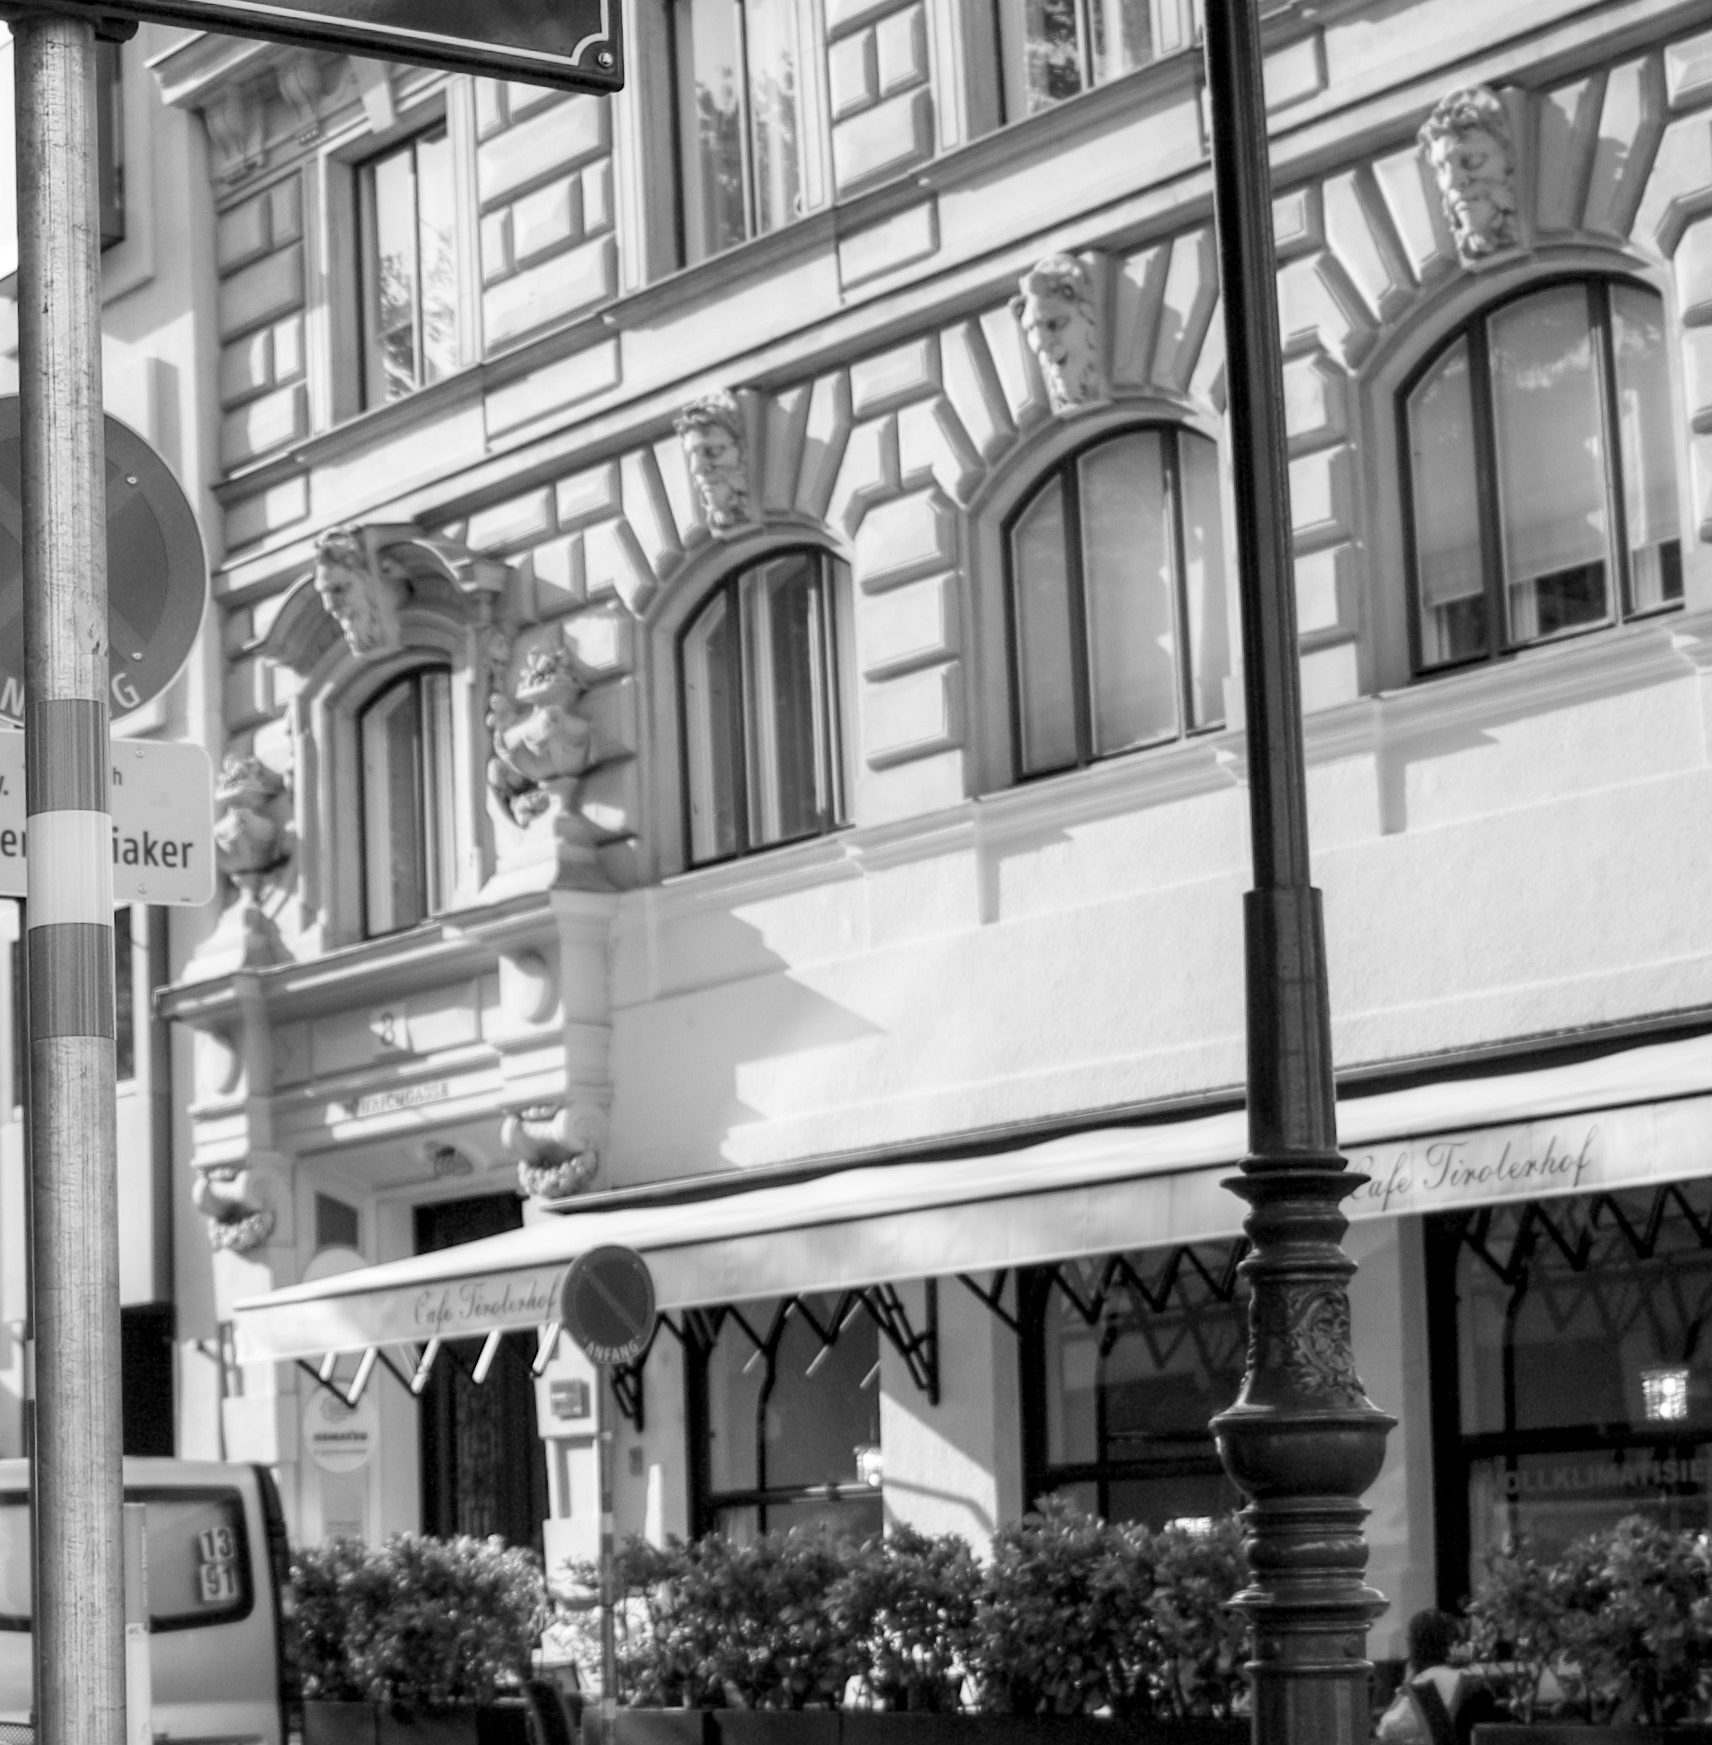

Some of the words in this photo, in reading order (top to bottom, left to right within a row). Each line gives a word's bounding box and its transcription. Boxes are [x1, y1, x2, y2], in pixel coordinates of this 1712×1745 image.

[111, 826, 194, 870] iaker
[1422, 1123, 1600, 1191] Tirolerhof
[585, 1339, 639, 1361] ANFANG
[202, 1528, 234, 1561] 13
[205, 1565, 238, 1597] 91
